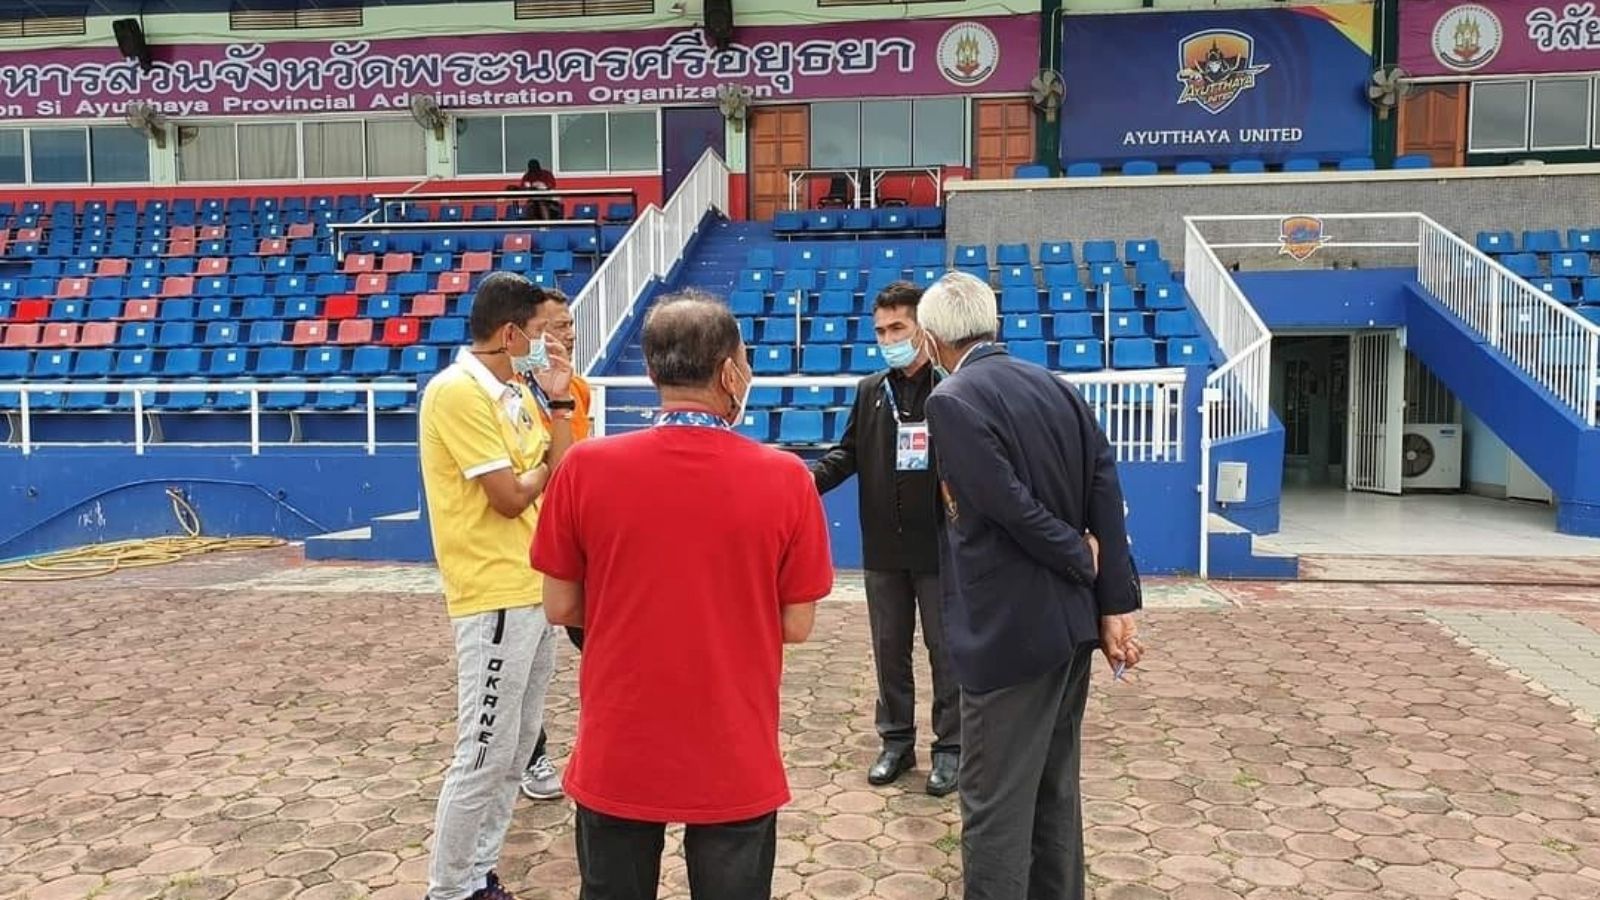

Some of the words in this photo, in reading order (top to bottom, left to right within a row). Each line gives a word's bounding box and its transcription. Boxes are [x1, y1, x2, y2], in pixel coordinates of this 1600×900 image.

[1187, 74, 1253, 98] AYUTTHAYA
[37, 100, 61, 116] Si
[223, 94, 355, 112] Provincial
[1123, 129, 1231, 146] AYUTTHAYA
[1239, 127, 1303, 143] UNITED
[477, 658, 504, 745] OKANE
